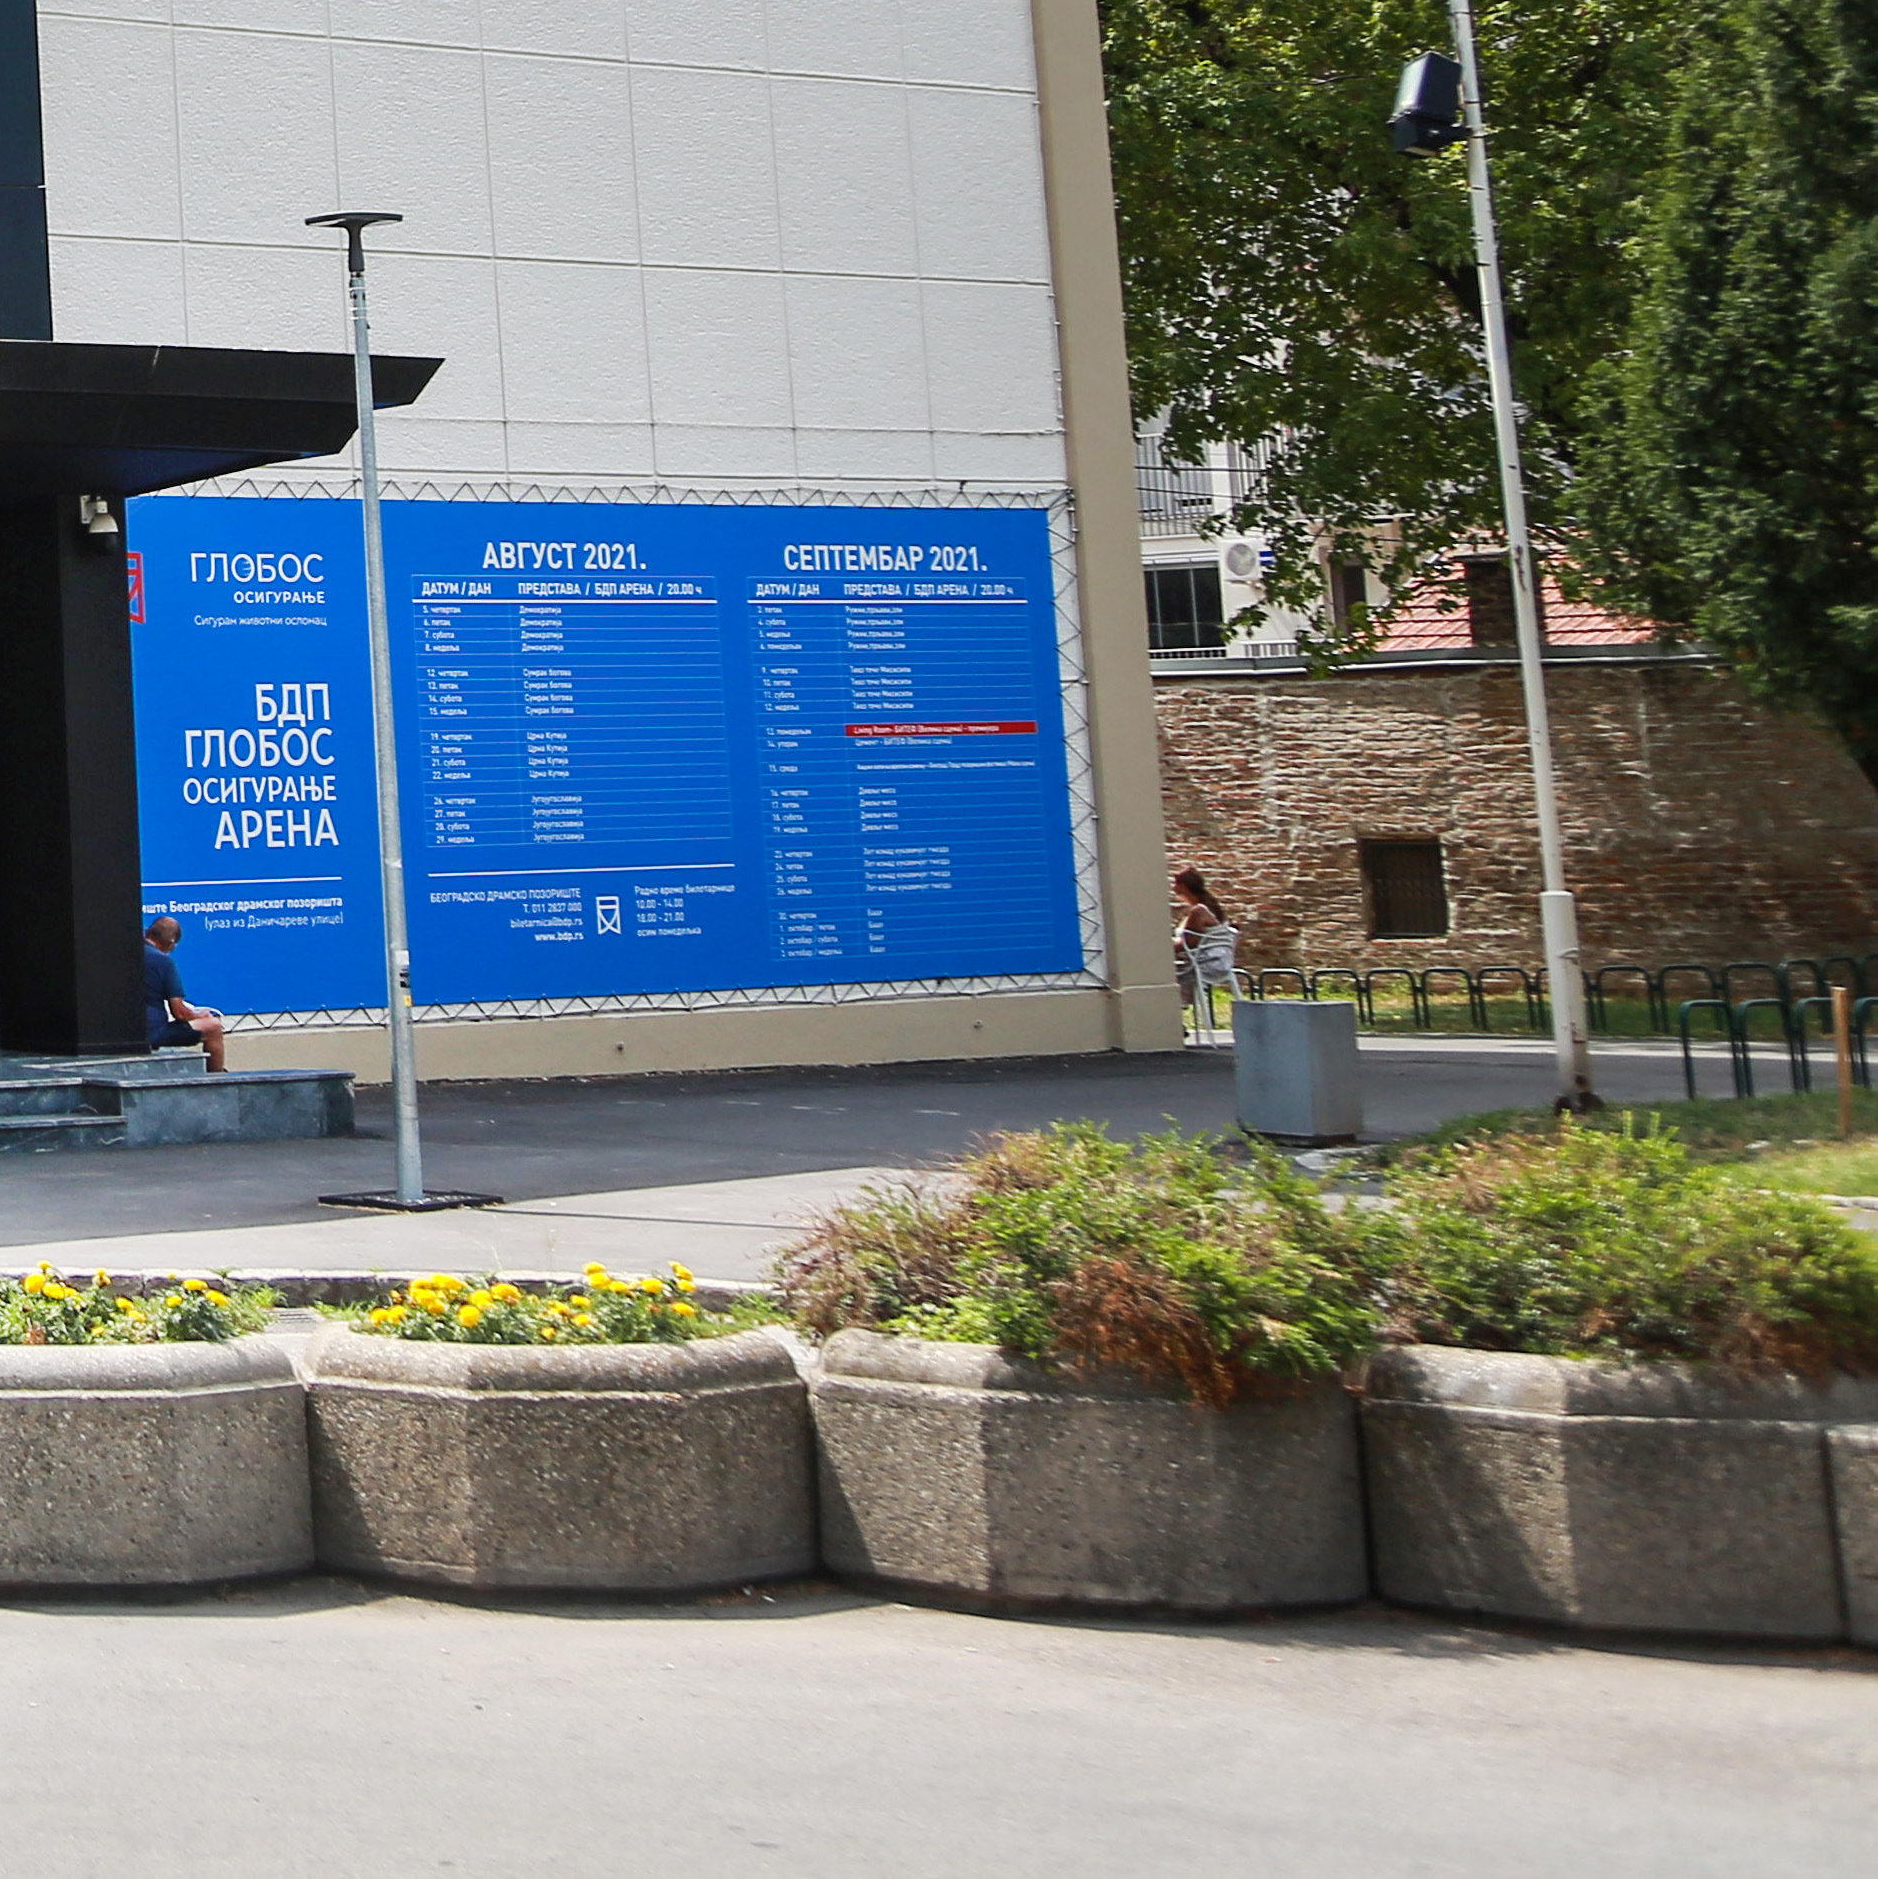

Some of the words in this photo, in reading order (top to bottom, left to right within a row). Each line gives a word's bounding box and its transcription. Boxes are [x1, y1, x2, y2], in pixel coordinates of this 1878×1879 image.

[190, 552, 324, 583] ГЛОБОС
[482, 542, 576, 569] АВГУСТ
[583, 543, 647, 570] 2021.
[784, 544, 924, 571] СЕПТЕМБАР
[929, 546, 988, 571] 2021.
[233, 590, 325, 604] ОСИГУРАЊЕ
[422, 582, 459, 596] ДАТУМ
[468, 582, 491, 596] ДАН
[518, 582, 581, 596] ПРЕДСТАВА
[595, 583, 617, 596] БДП
[619, 583, 654, 595] АРЕНА
[667, 583, 694, 595] 20.00
[756, 584, 790, 597] ДАТУМ
[798, 584, 820, 597] ДАН
[844, 584, 902, 597] ПРЕДСТАВА
[914, 584, 935, 597] БДП
[936, 584, 969, 595] АРЕНА
[255, 683, 330, 727] БДП
[185, 727, 335, 768] ГЛОБОС
[183, 775, 337, 804] ОСИГУРАЊЕ
[214, 808, 339, 849] АРЕНА
[430, 891, 485, 903] БЕОГРАДСКО
[487, 890, 527, 902] ДРАМСКО
[529, 888, 581, 899] ПОЗОРИШТЕ
